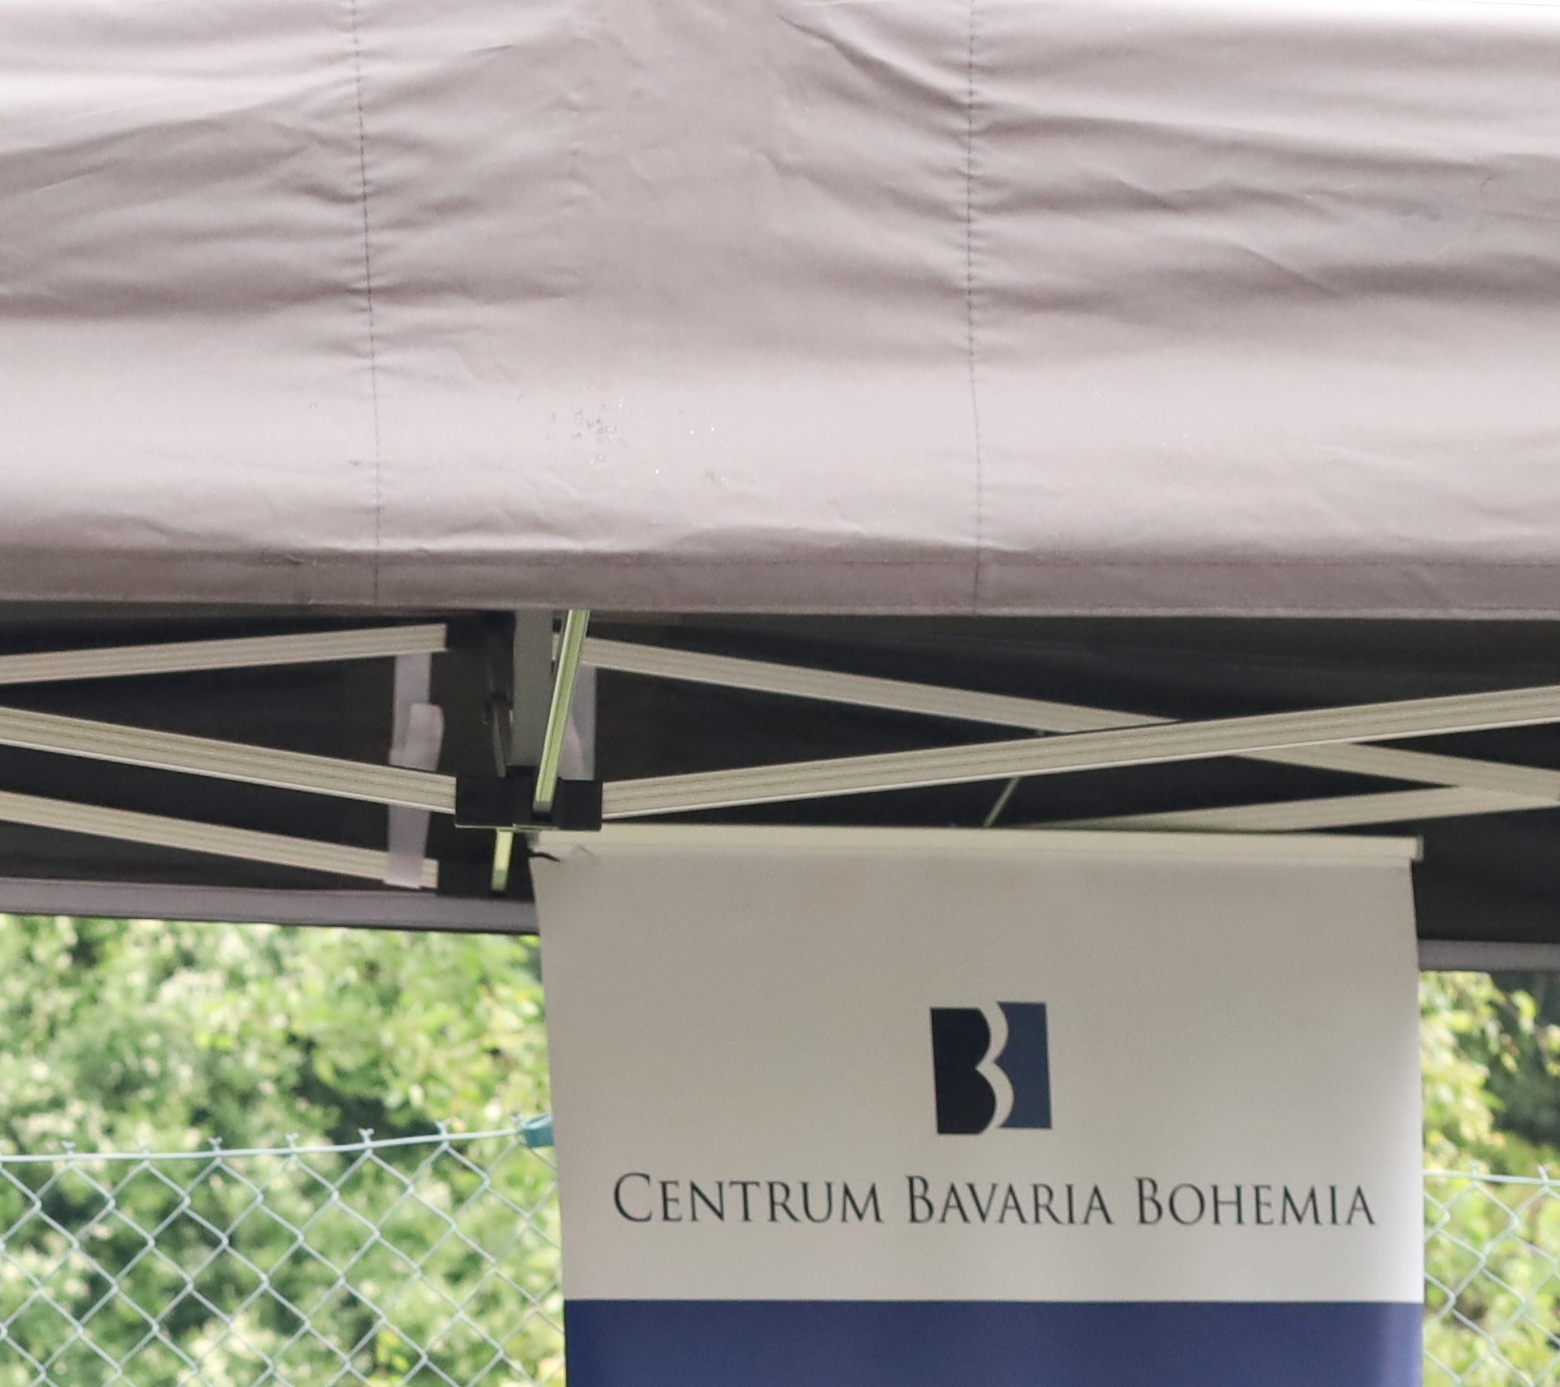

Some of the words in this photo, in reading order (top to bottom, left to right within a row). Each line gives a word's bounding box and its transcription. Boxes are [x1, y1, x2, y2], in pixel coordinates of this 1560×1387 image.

[613, 1171, 883, 1224] CENTRUM
[906, 1175, 1114, 1226] BAVARIA
[1135, 1176, 1376, 1227] BOHEMIA
